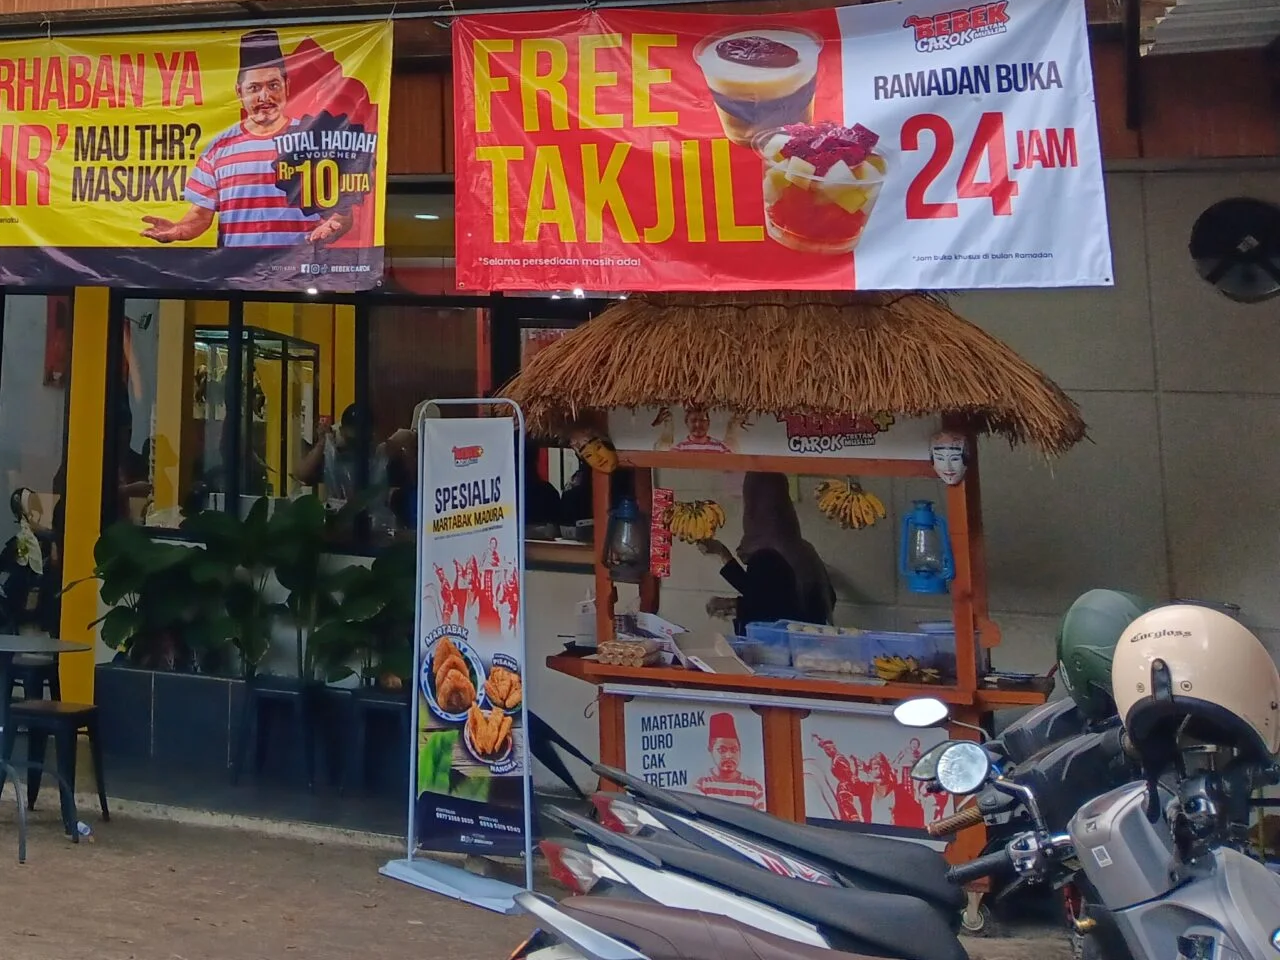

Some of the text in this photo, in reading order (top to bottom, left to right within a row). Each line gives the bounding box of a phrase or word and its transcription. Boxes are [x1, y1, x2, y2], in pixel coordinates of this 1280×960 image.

[904, 1, 1009, 40] BEBEK
[916, 29, 972, 51] CAROK
[156, 50, 204, 107] YA
[472, 34, 679, 132] FREE
[873, 59, 1063, 101] RAMADAN BUKA
[74, 123, 202, 161] MAU THR?
[274, 130, 377, 154] TOTAL HADIAH
[293, 150, 357, 161] E-VOUCHER
[899, 111, 1078, 220] 24 JAM
[71, 165, 191, 203] MASUKK!
[278, 159, 370, 208] Rp 10 JUTA
[475, 139, 765, 244] TAKJIL
[522, 257, 580, 268] persediaan
[581, 257, 614, 266] masih
[933, 253, 952, 261] buka
[982, 252, 990, 260] di
[789, 434, 842, 453] CAROK
[435, 476, 501, 514] SPESIALIS
[433, 513, 472, 533] MARTABAK
[474, 506, 504, 525] MADURA
[425, 624, 469, 647] MARTABAK
[493, 659, 518, 672] PISANG
[641, 710, 706, 732] MARTABAK
[642, 732, 673, 751] DURO
[490, 761, 518, 773] NANGKA
[642, 753, 666, 770] CAK
[643, 770, 688, 788] TRETAN
